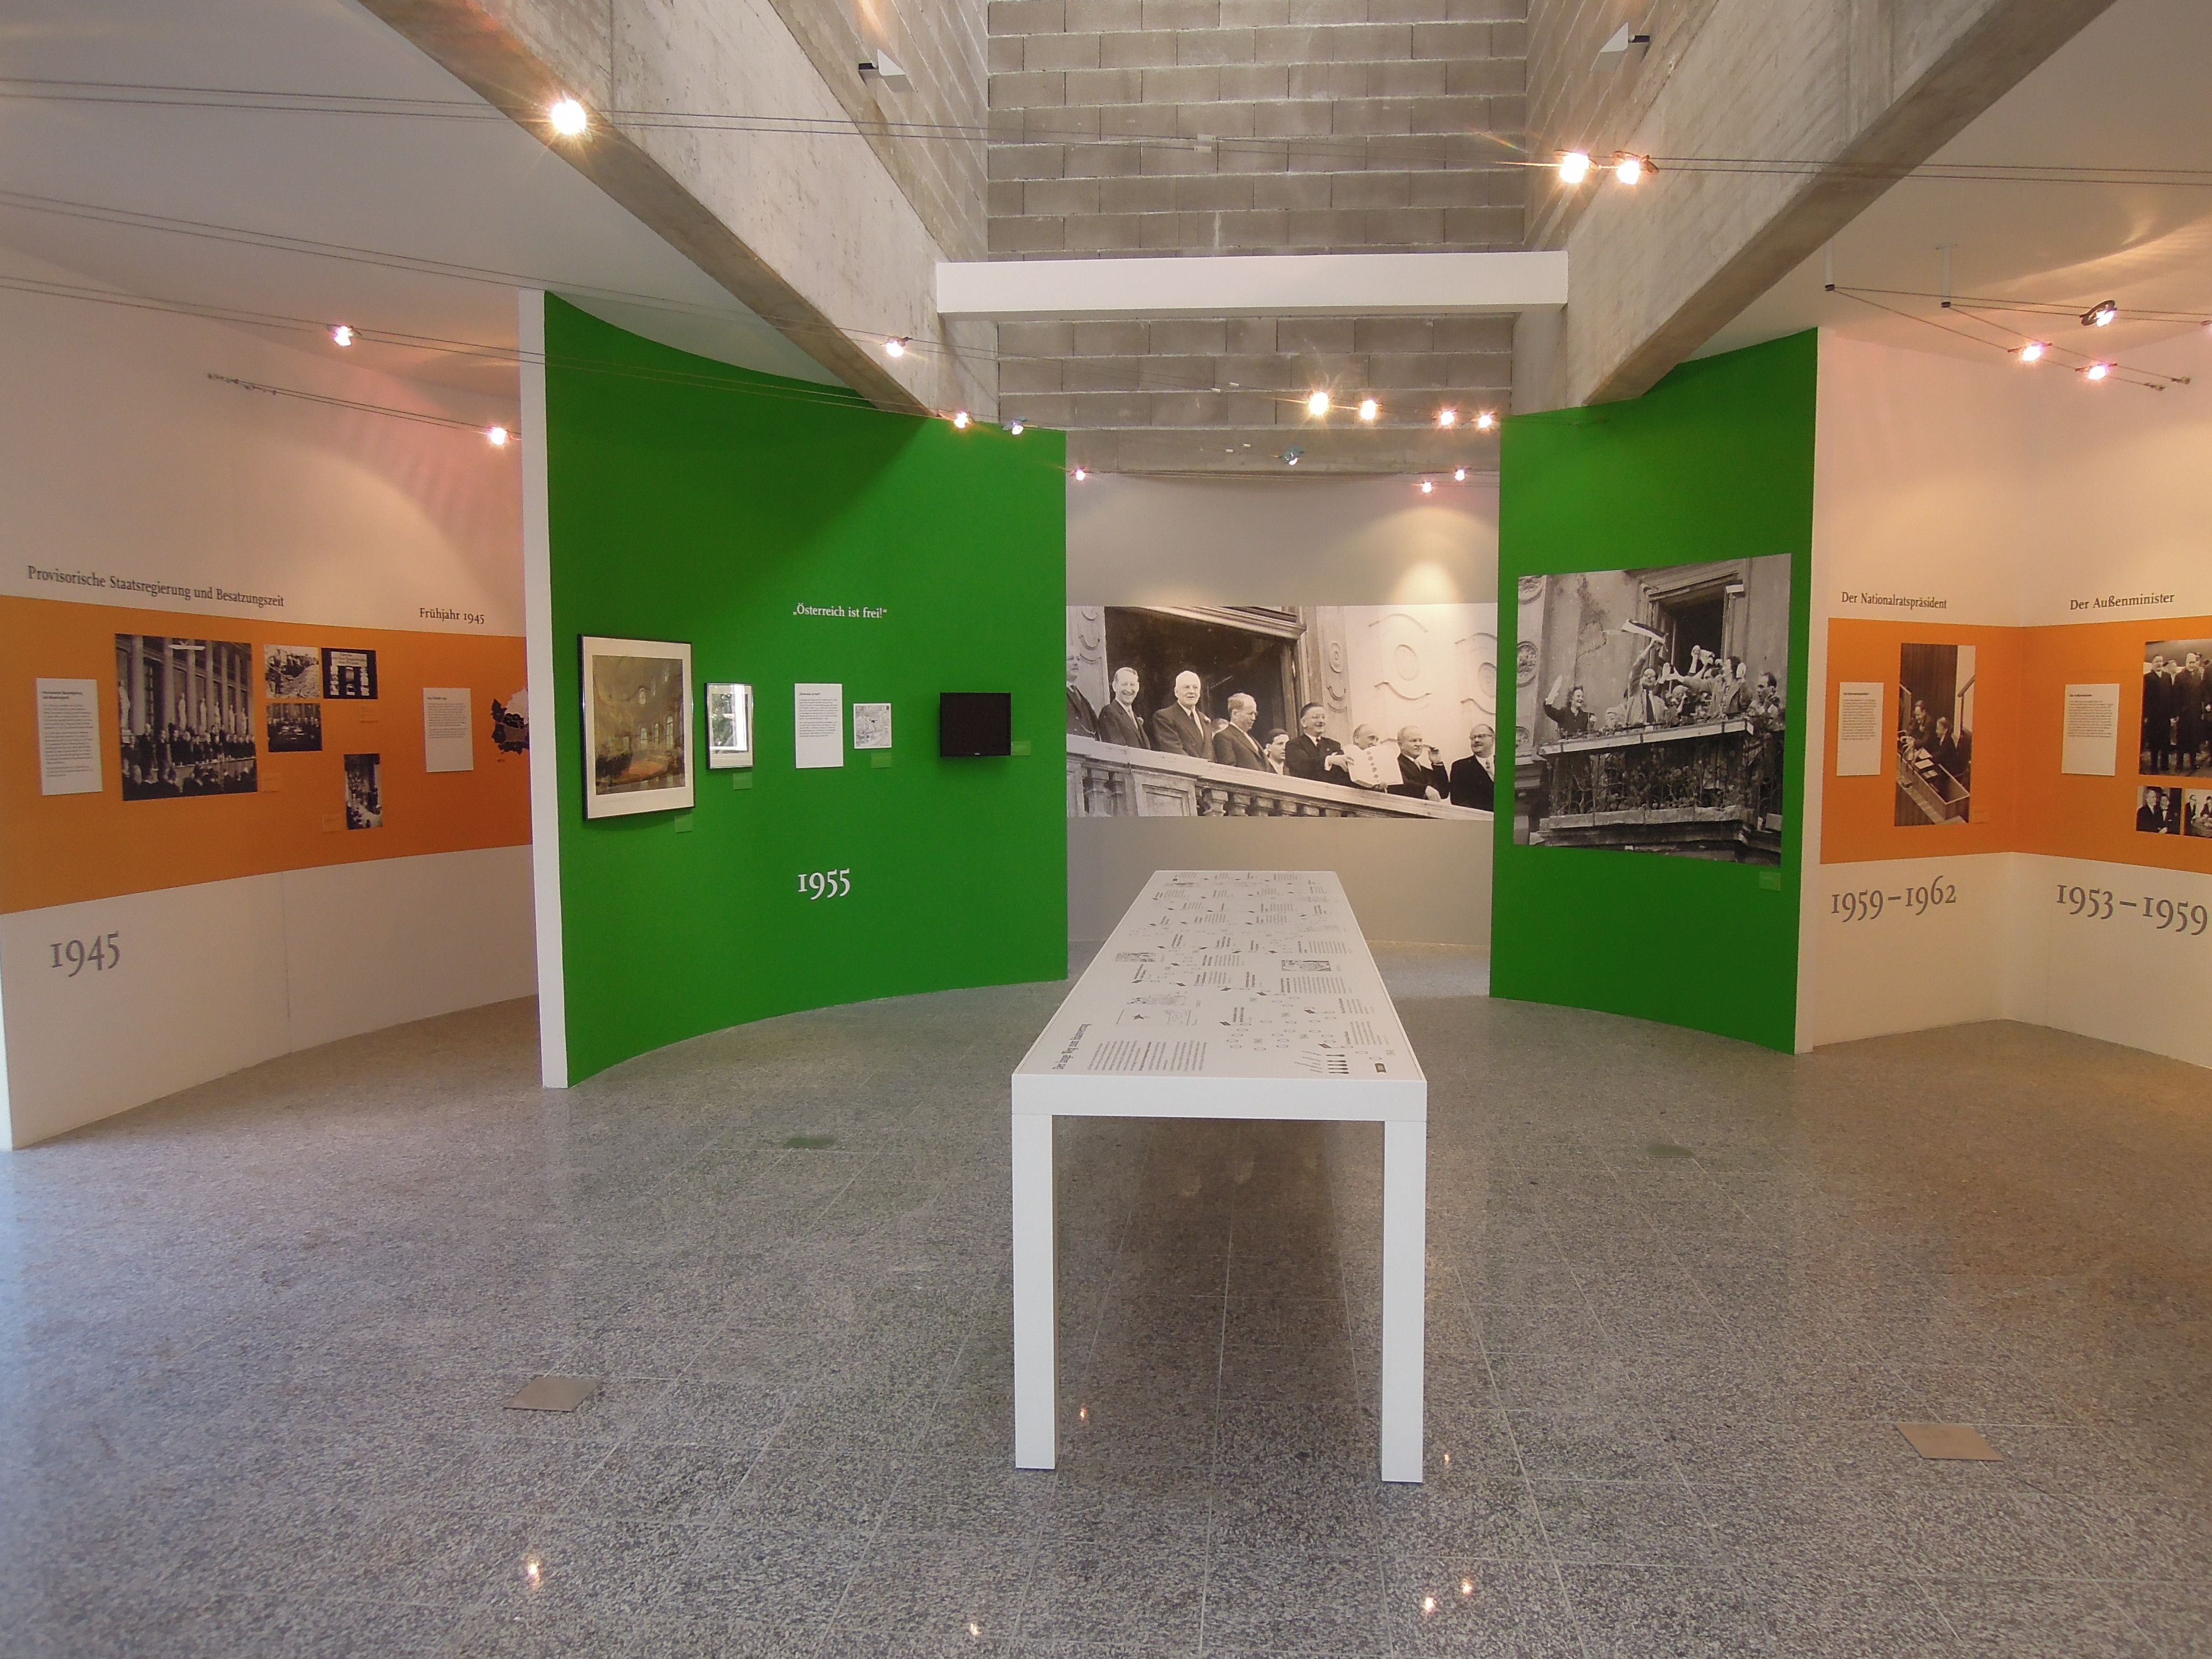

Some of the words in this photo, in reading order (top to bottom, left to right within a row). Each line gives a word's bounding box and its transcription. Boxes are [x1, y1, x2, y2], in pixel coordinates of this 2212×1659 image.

[28, 565, 106, 587] Provisorische
[110, 576, 191, 600] Staatsregierung
[194, 587, 213, 600] und
[216, 588, 284, 608] Besatzungszeit
[793, 602, 845, 617] „Österreich
[848, 606, 860, 618] ist
[1841, 591, 1858, 603] Der
[1860, 593, 1947, 610] Nationalratspräsident
[2070, 599, 2089, 610] Der
[2092, 593, 2175, 608] Außenminister
[419, 607, 460, 622] Frühjahr
[463, 613, 484, 625] 1945
[797, 868, 851, 900] 1955
[50, 930, 120, 977] 1945
